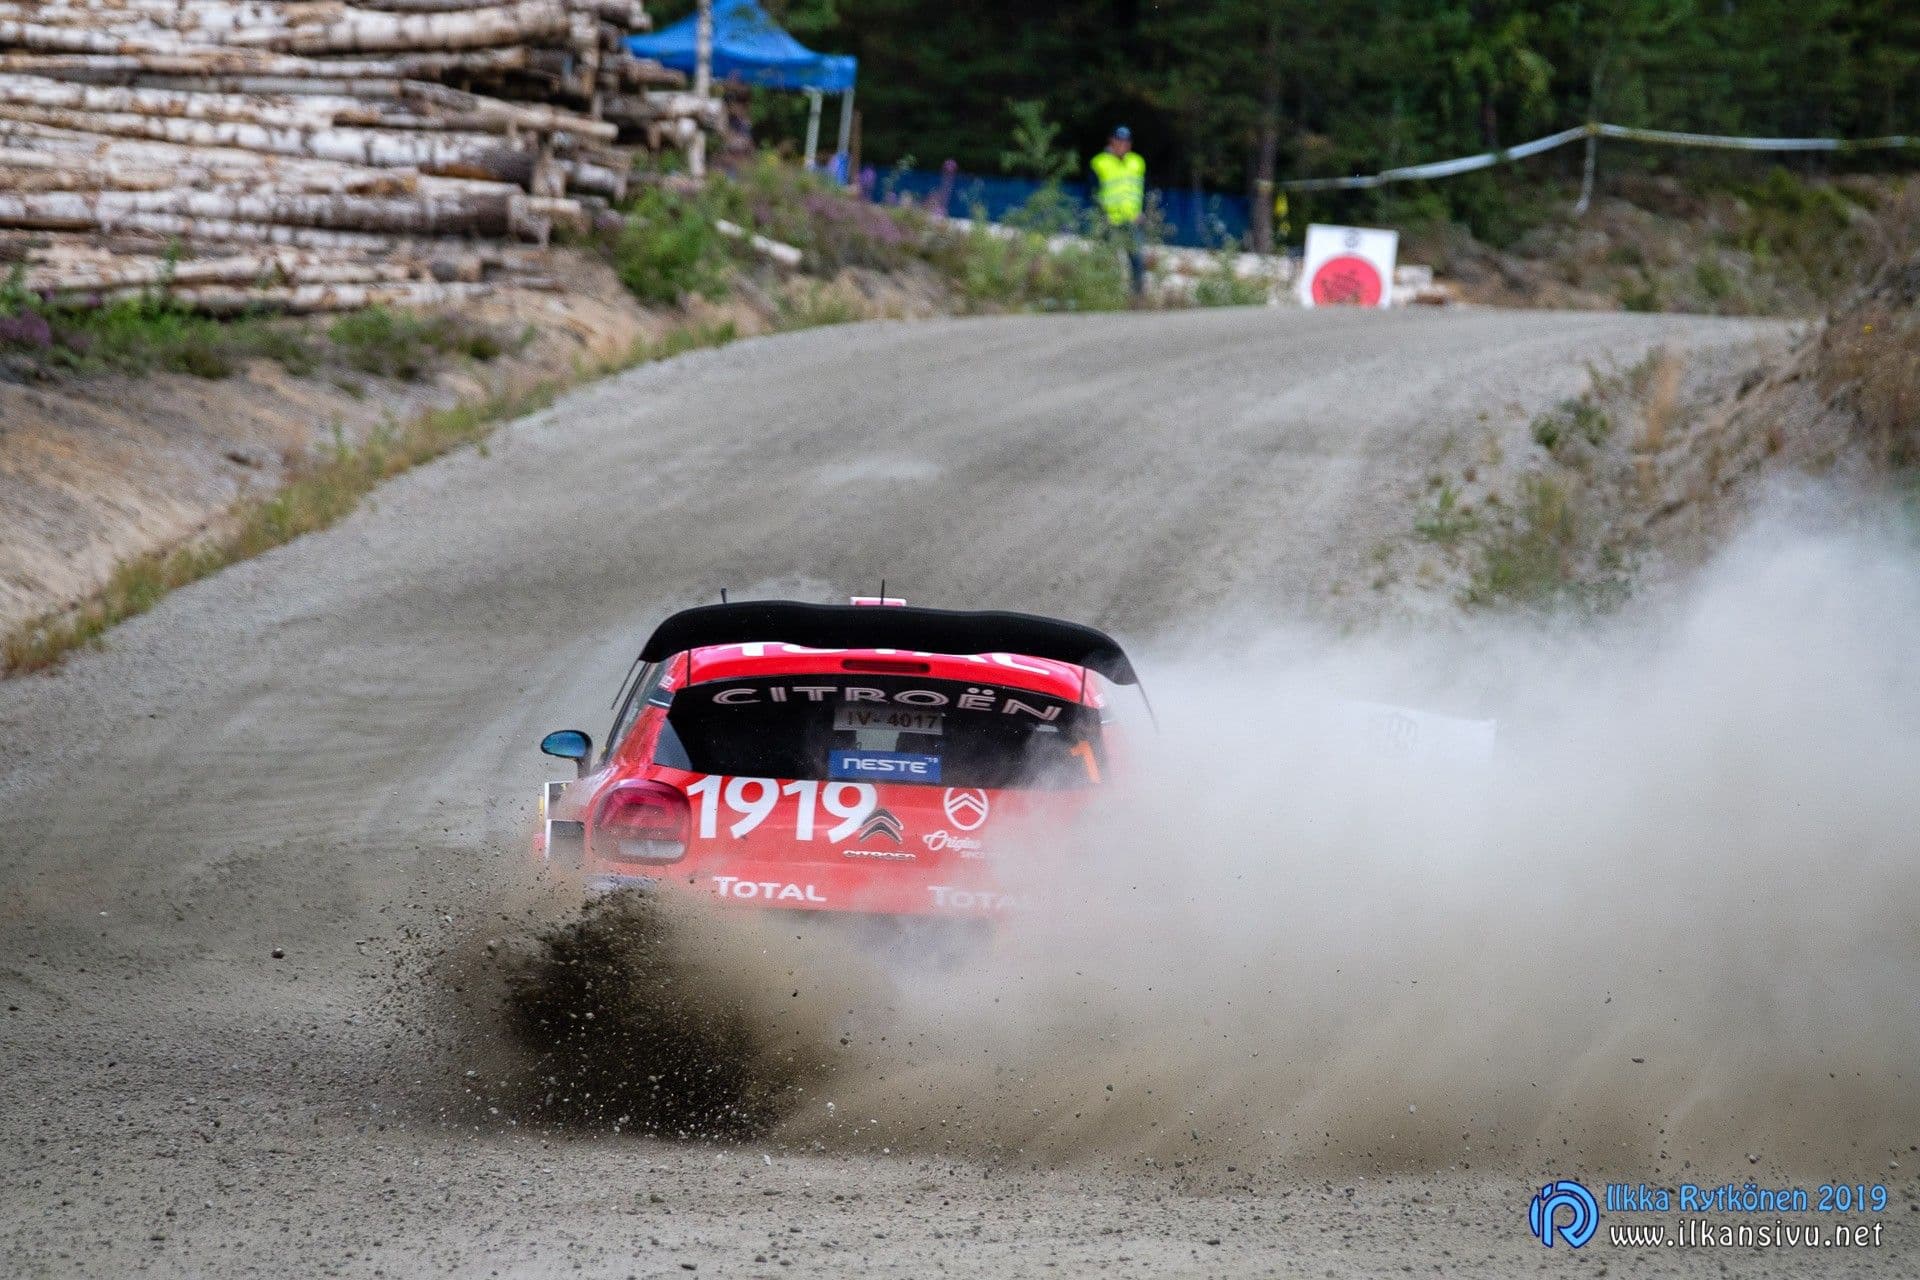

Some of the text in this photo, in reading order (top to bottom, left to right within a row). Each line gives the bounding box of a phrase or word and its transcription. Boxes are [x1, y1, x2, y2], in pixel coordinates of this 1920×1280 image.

[712, 686, 1063, 721] CITROËN
[843, 757, 927, 774] NESTE
[686, 775, 878, 844] 1919
[712, 876, 828, 902] TOTAL
